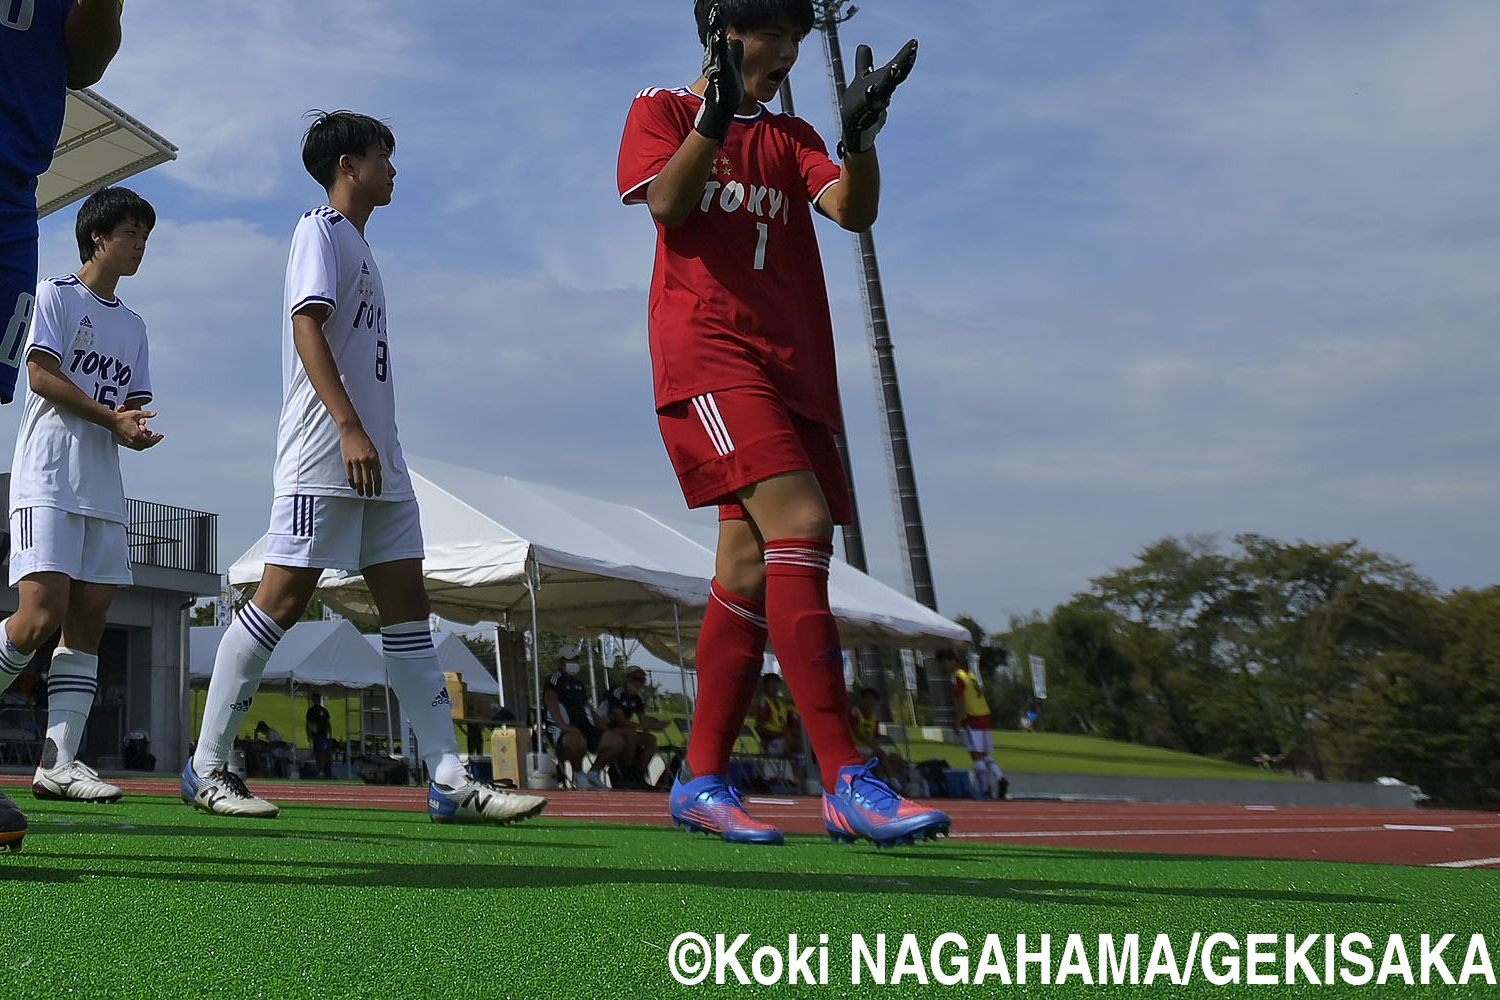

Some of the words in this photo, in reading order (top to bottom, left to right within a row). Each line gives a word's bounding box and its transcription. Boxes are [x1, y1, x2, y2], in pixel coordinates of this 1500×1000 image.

[753, 222, 768, 270] 1
[70, 349, 132, 386] TOKYO
[376, 340, 387, 382] 8
